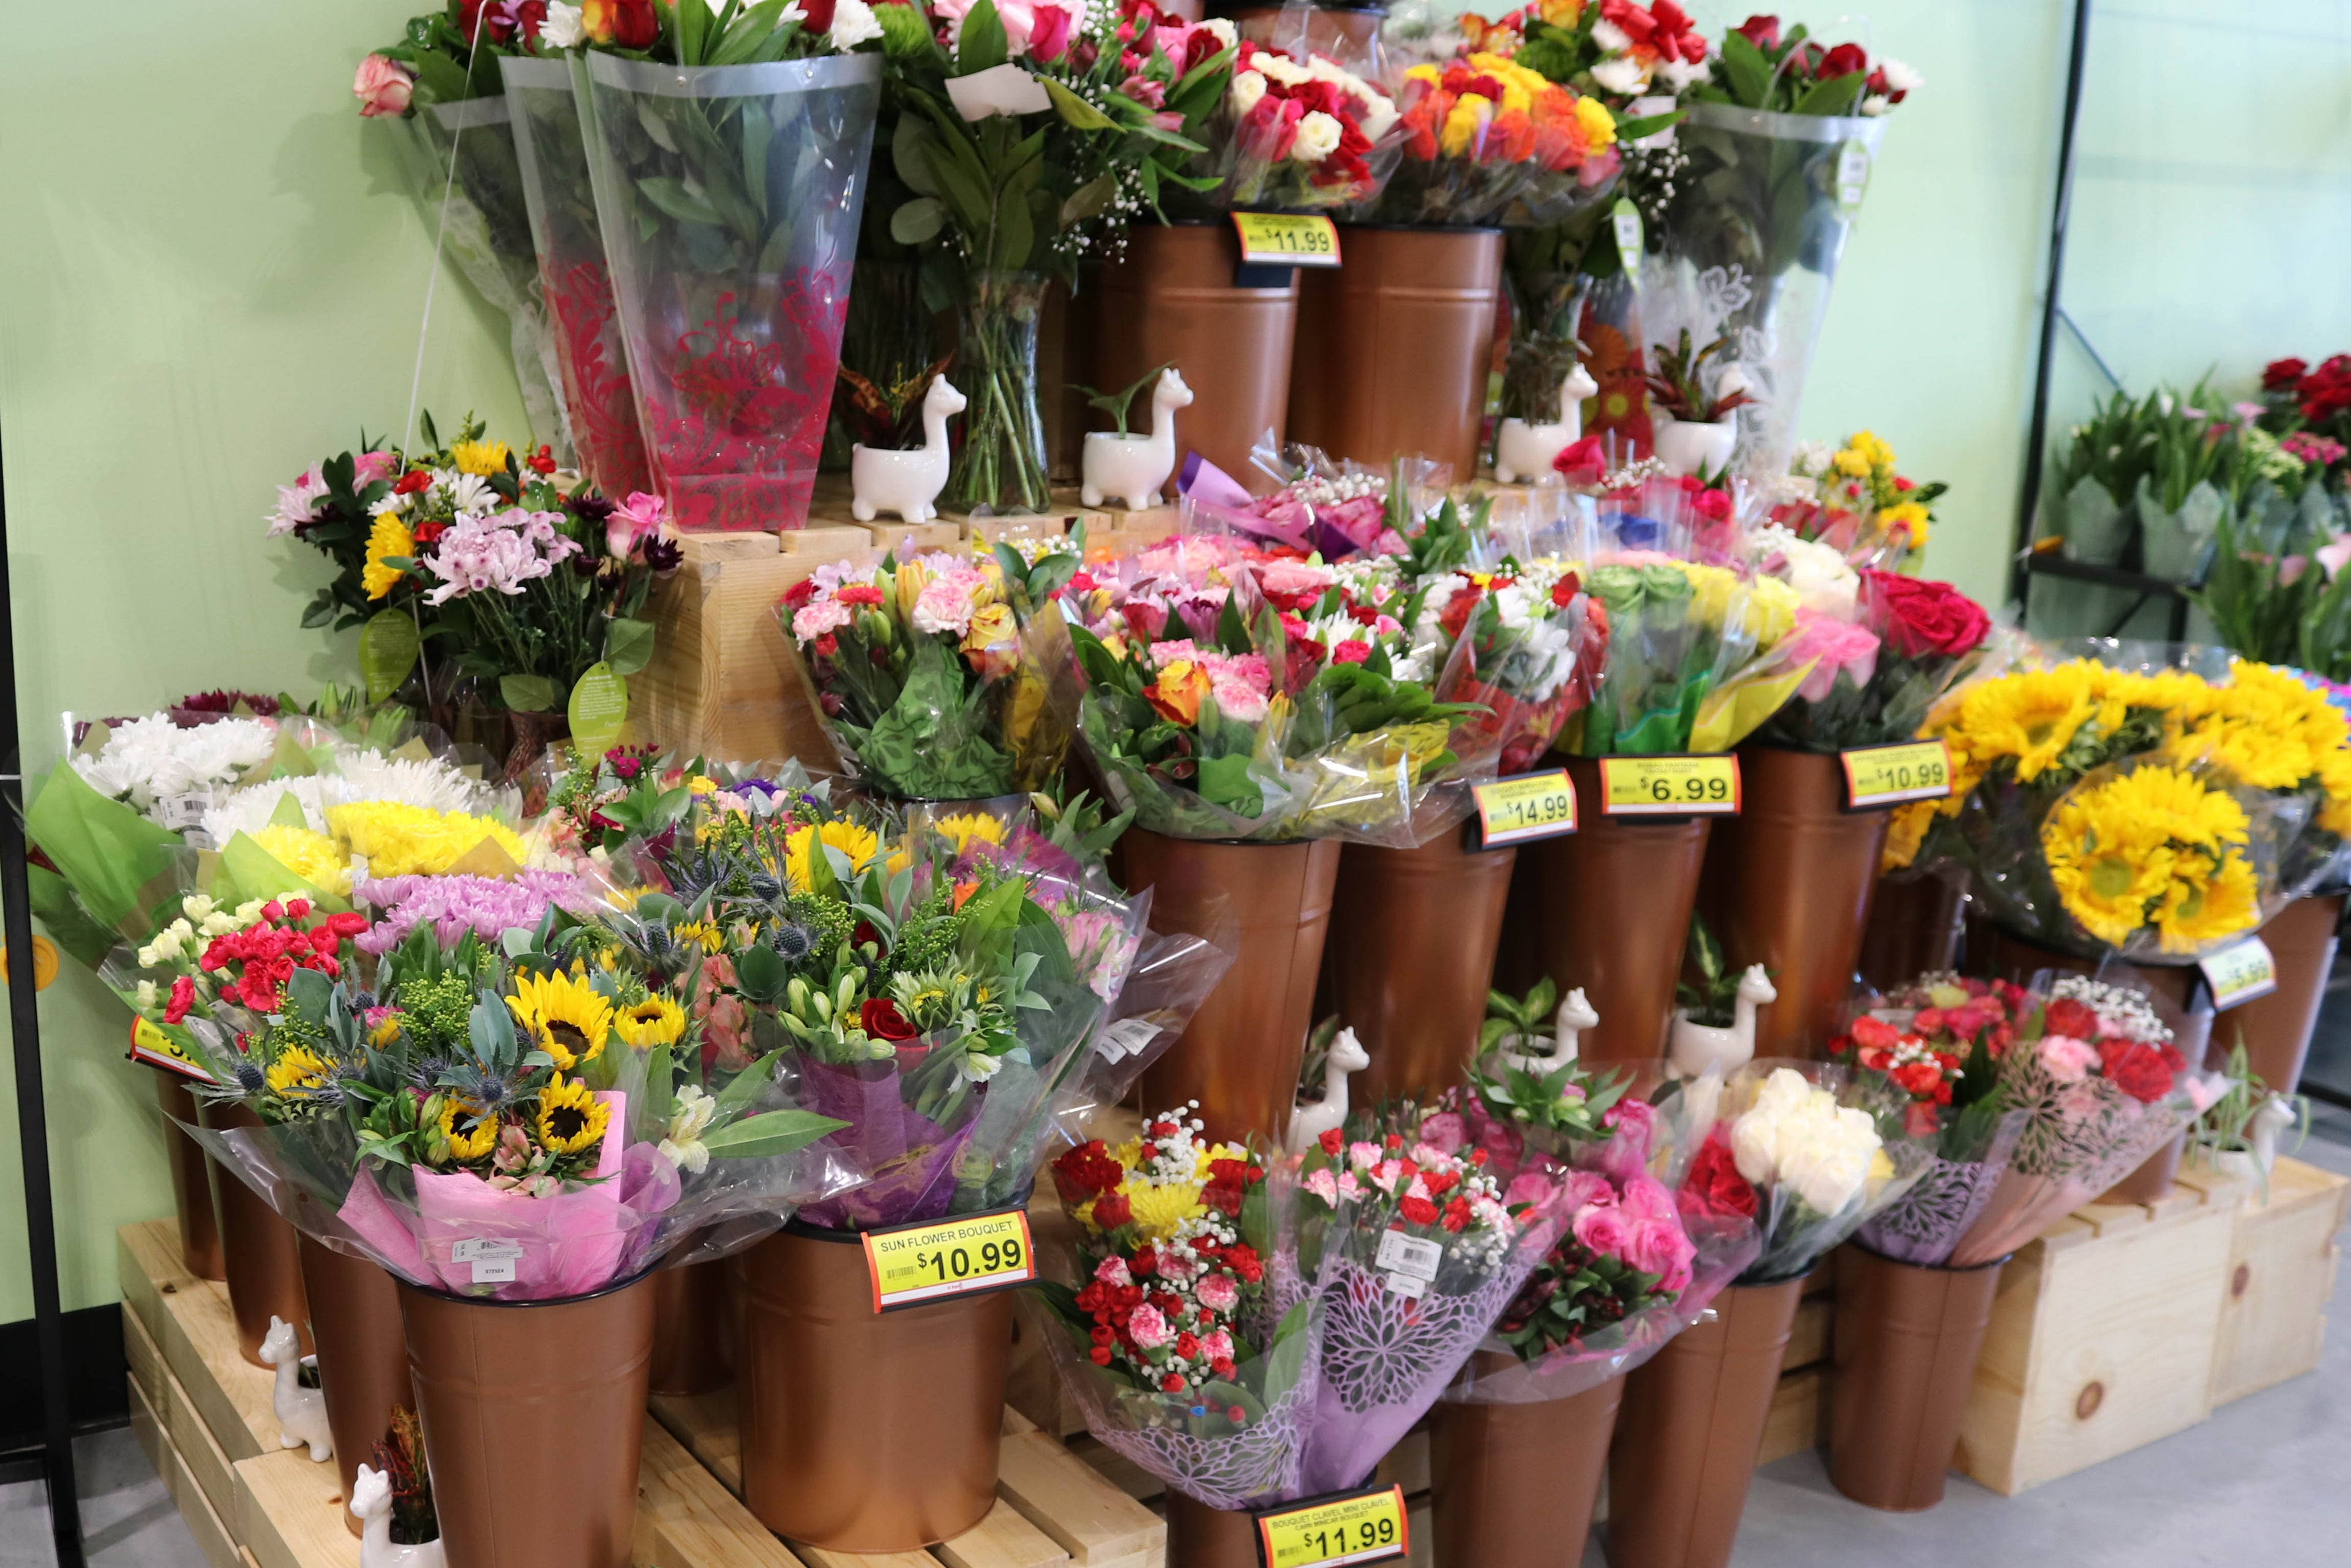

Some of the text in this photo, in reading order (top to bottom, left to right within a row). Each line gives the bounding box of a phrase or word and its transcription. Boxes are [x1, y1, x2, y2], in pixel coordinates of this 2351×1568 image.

[1265, 228, 1330, 252] $11.99
[1640, 776, 1727, 800] $6.99
[1877, 763, 1944, 790] $10.99
[1506, 795, 1568, 825] $14.99
[880, 1221, 1013, 1252] SUN FLOWER BOUQUET
[917, 1239, 1021, 1280] $10.99
[1272, 1514, 1311, 1529] BOUQUET
[1311, 1509, 1342, 1522] CLAVEL
[1361, 1499, 1390, 1510] CLAVEL
[1303, 1518, 1394, 1557] $11.99
